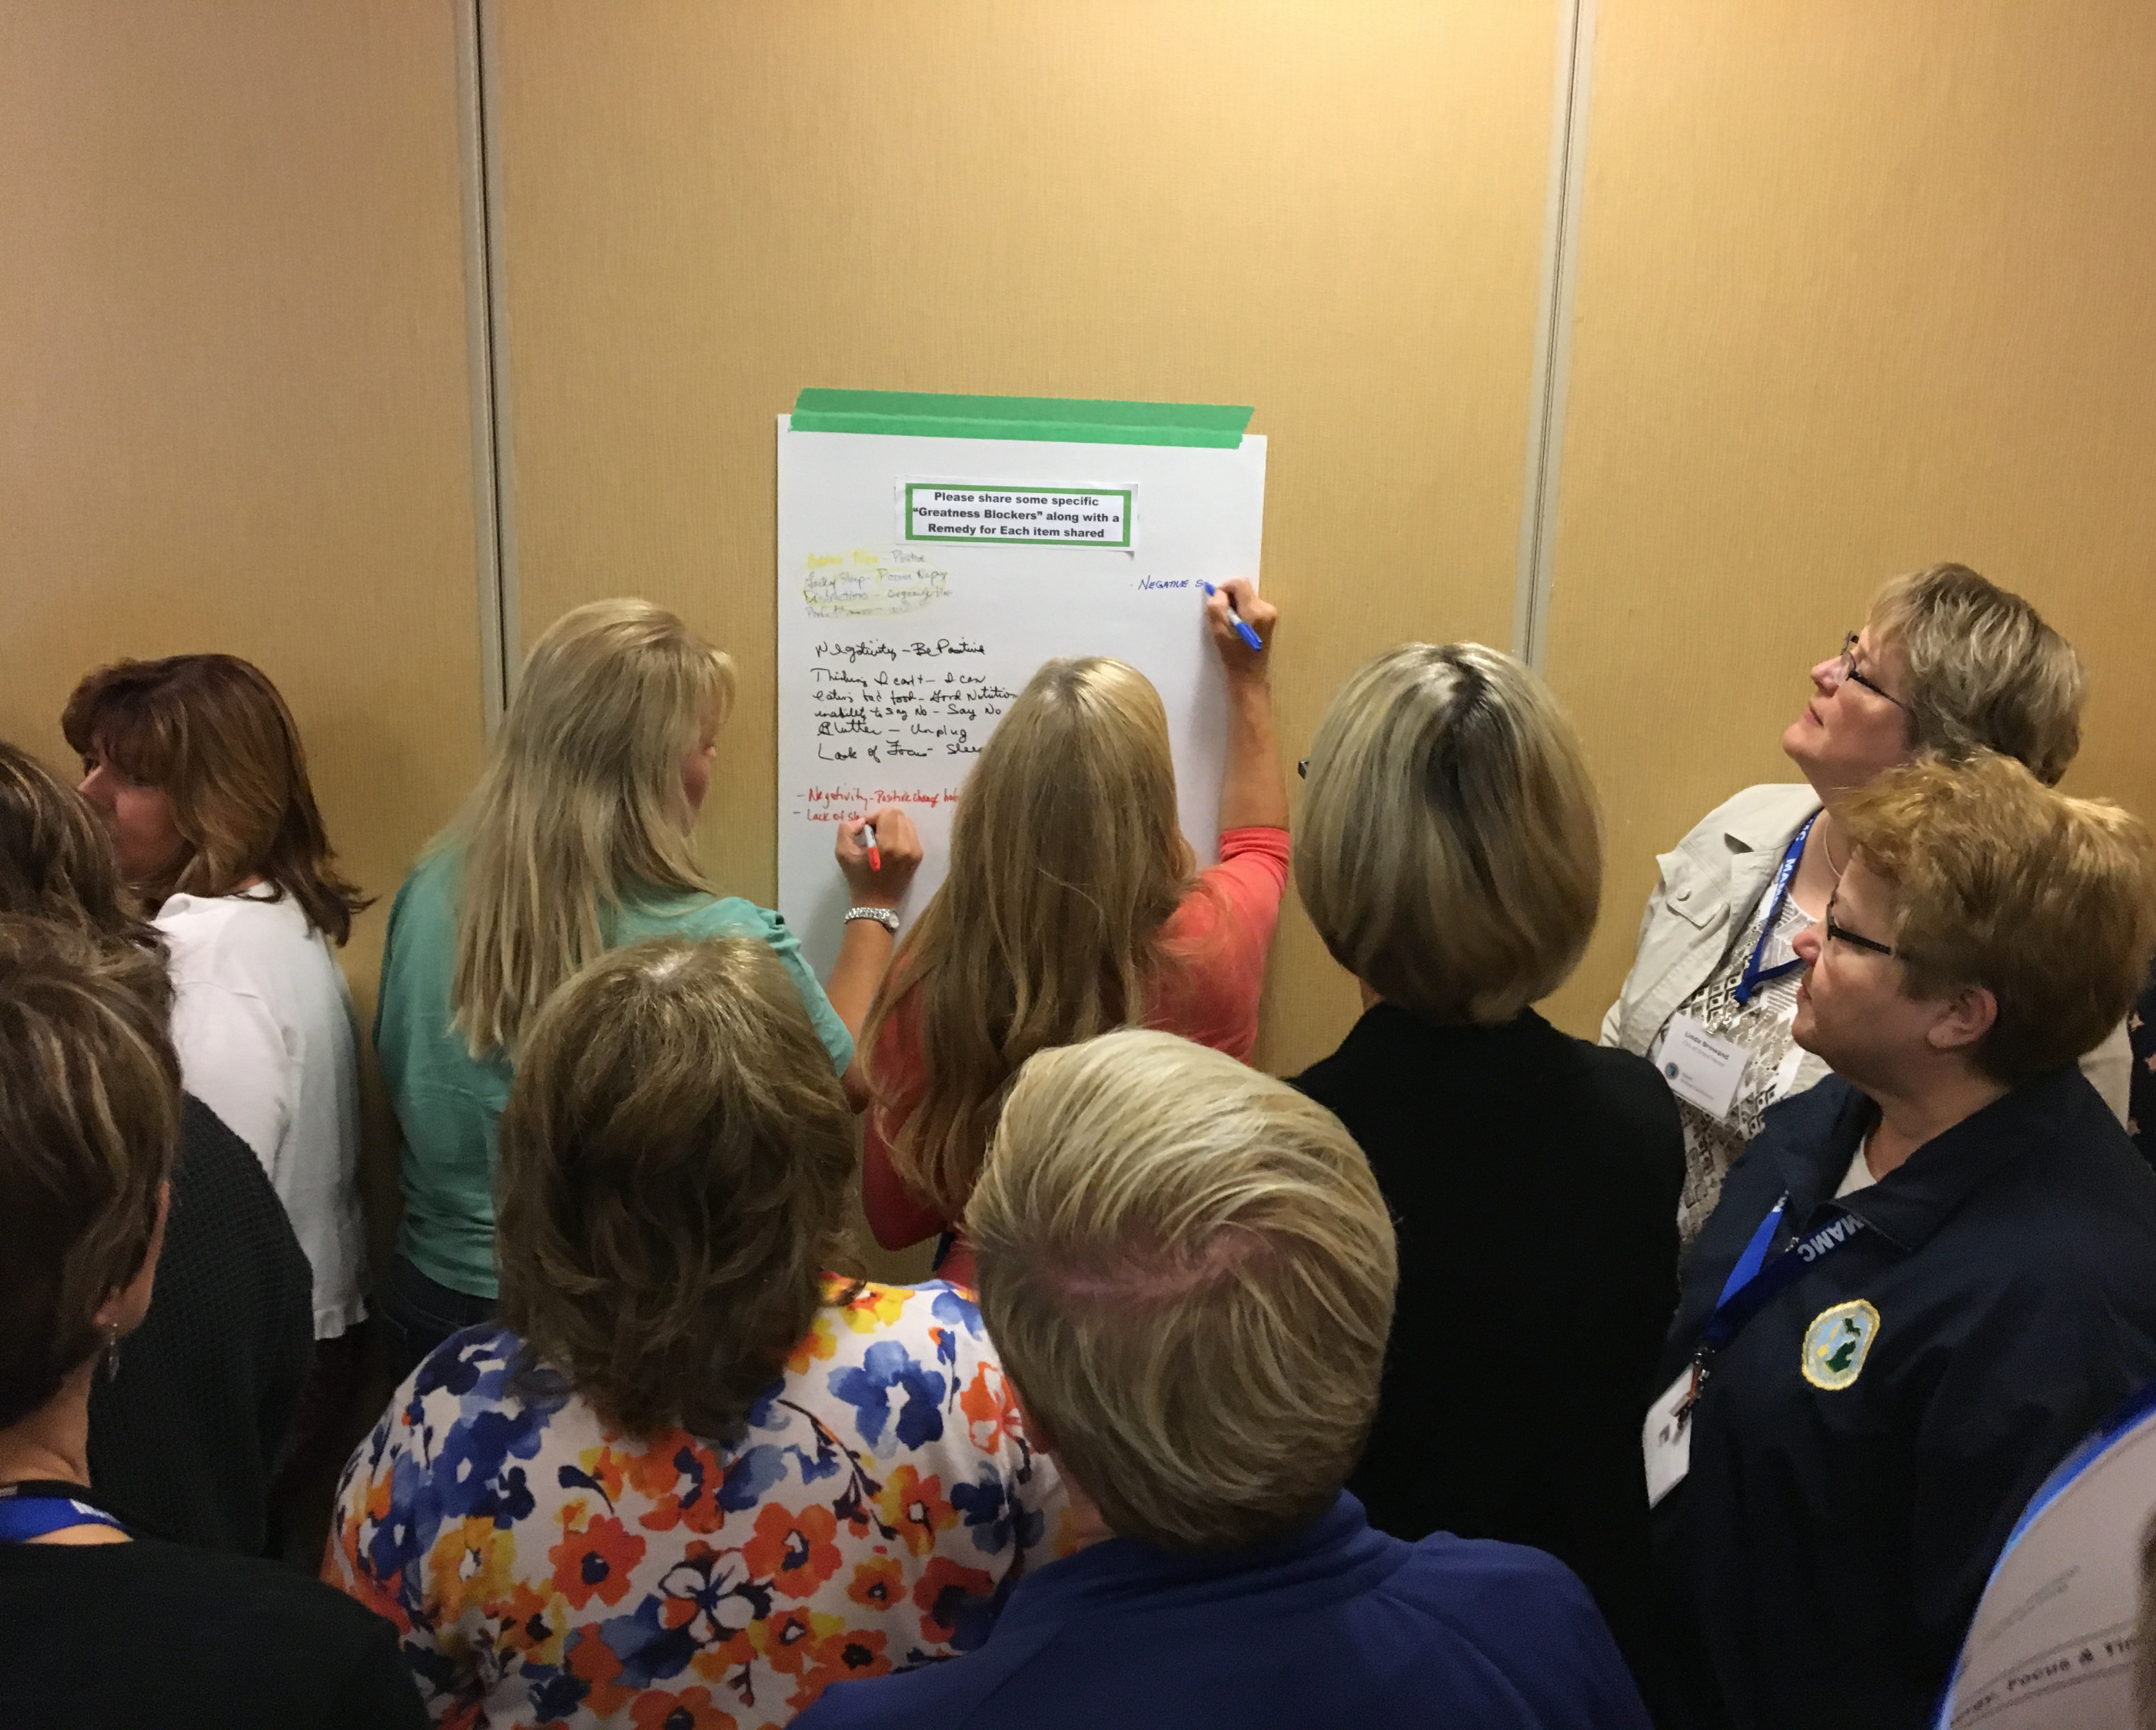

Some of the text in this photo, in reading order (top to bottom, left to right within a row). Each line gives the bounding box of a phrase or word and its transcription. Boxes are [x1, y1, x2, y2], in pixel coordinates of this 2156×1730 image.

[934, 491, 1100, 507] Please share some specific
[913, 507, 980, 518] “Greatness
[984, 509, 1043, 520] Blockers”
[1046, 511, 1080, 524] along
[1083, 513, 1109, 522] with
[928, 523, 1105, 538] Remedy for Each item shared
[910, 642, 940, 657] Be
[937, 637, 986, 656] Positive
[810, 667, 867, 687] Thinking
[960, 675, 986, 684] can
[947, 703, 977, 721] Say
[985, 703, 1001, 715] No
[911, 724, 967, 744] Unplug
[818, 743, 857, 760] Lack
[868, 745, 881, 763] of
[947, 743, 984, 755] Slee
[808, 783, 867, 810] Negativity
[874, 790, 912, 804] Positive
[807, 809, 830, 821] Lack
[833, 810, 844, 821] of
